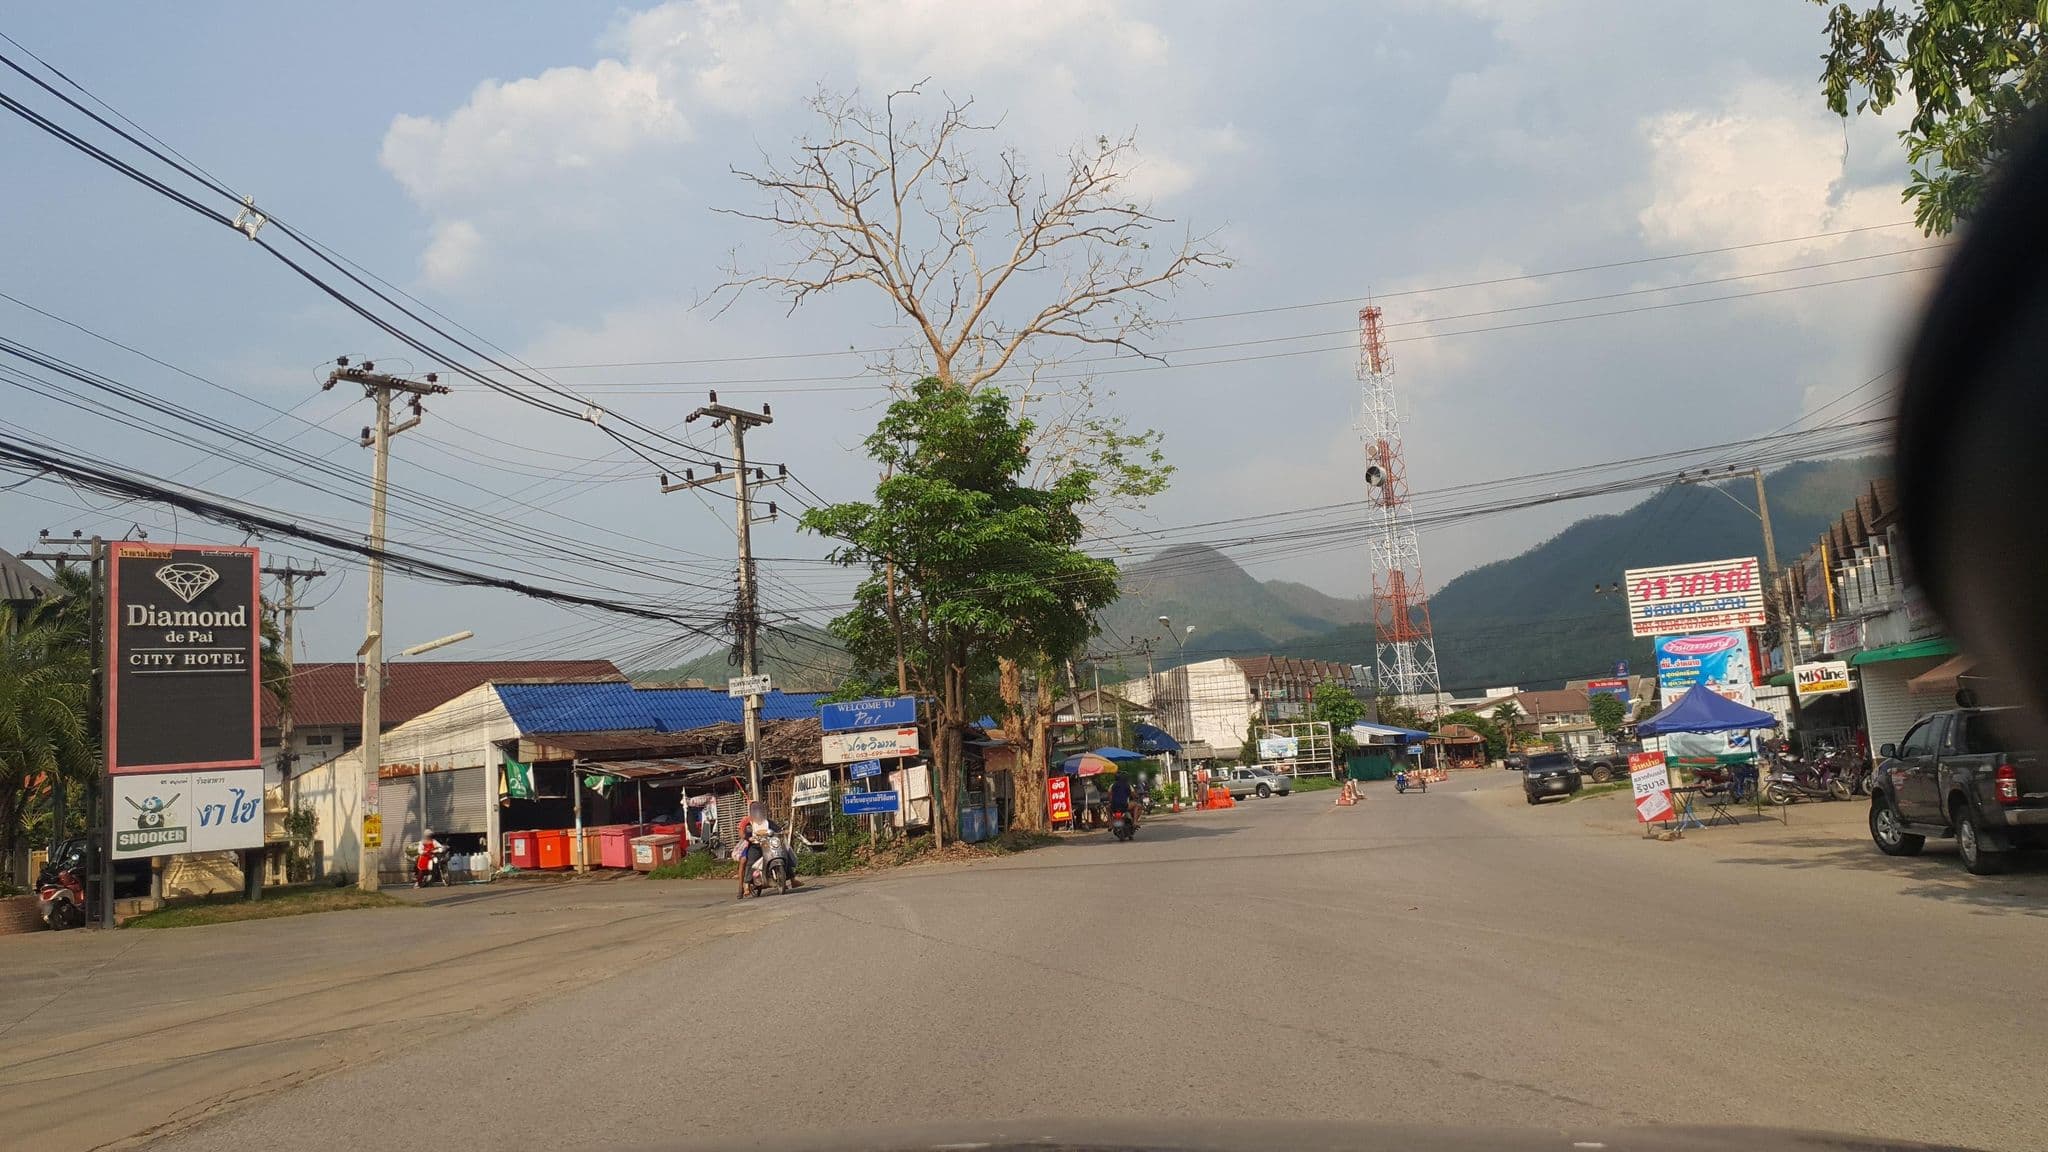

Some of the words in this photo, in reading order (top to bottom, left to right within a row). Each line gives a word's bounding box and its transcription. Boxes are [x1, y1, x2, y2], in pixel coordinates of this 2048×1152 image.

[1634, 558, 1756, 600] วราภรณ์
[127, 604, 247, 627] Diamond
[165, 631, 185, 643] de
[188, 630, 214, 643] Pai
[130, 653, 176, 665] CITY
[184, 653, 245, 665] HOTEL
[838, 701, 881, 712] WELCOME
[883, 700, 896, 709] TO
[854, 711, 881, 725] Pai
[1631, 754, 1660, 771] จำหน่าย
[1636, 778, 1666, 794] รัฐบาล
[119, 830, 185, 846] SNOOKER
